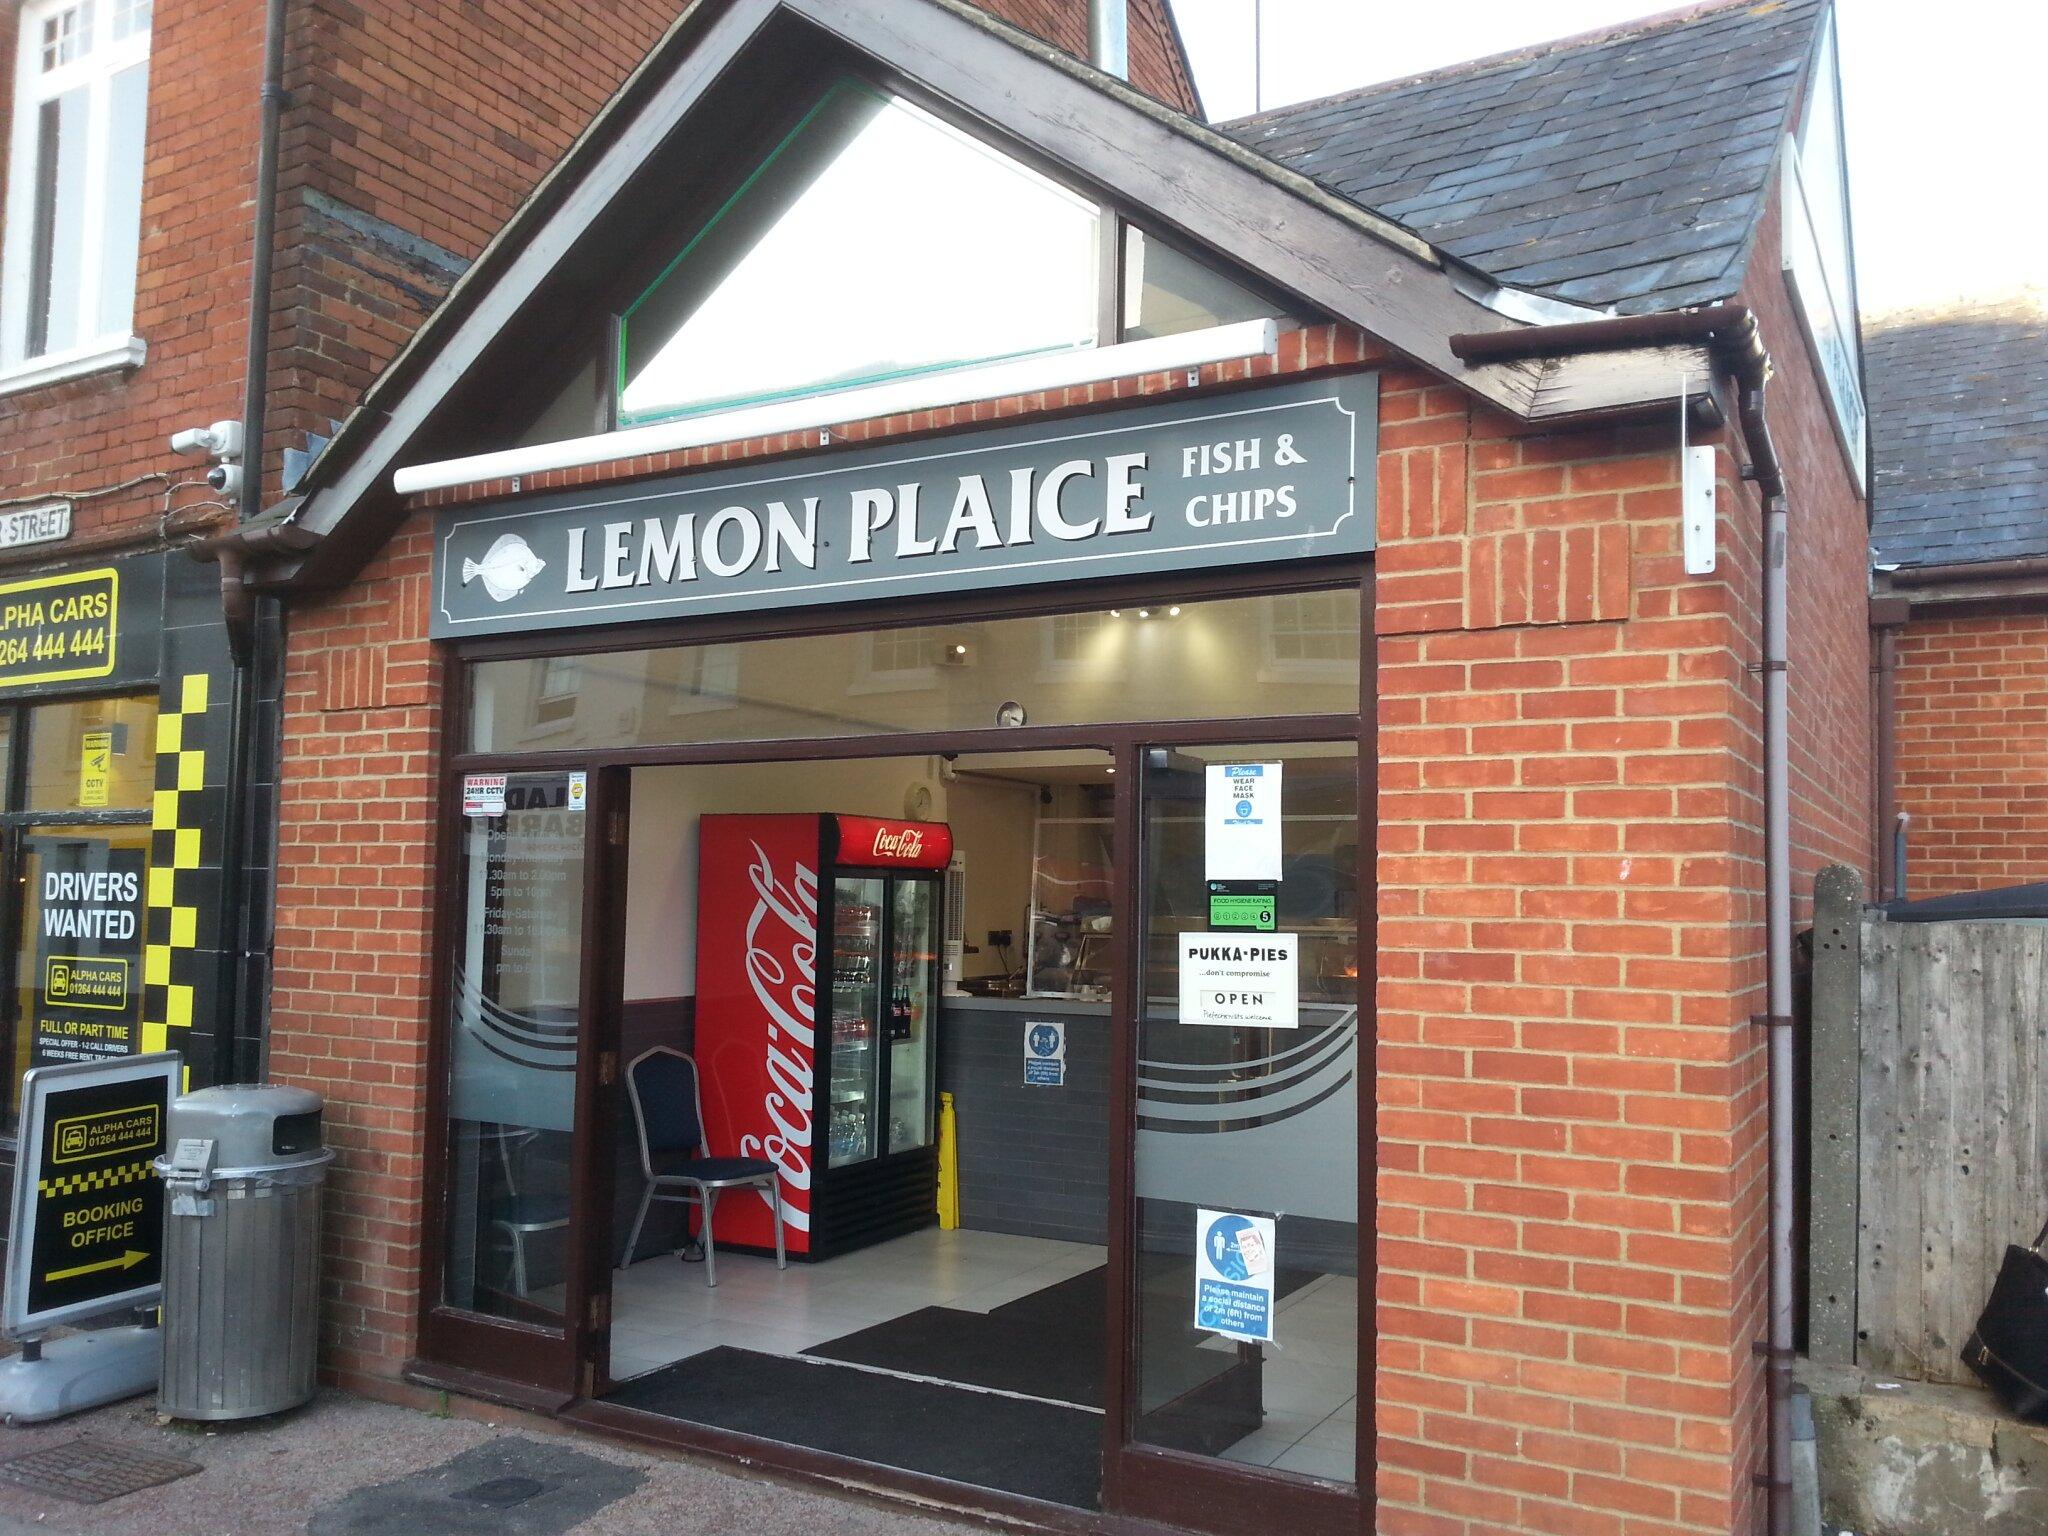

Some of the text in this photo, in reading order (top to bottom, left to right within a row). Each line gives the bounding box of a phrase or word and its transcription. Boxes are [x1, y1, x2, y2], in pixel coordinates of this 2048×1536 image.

[1182, 432, 1307, 479] FISH &
[1184, 484, 1297, 528] CHIPS
[9, 508, 67, 541] STREET
[565, 452, 1154, 593] LEMON PLAICE
[50, 592, 107, 623] CARS
[33, 631, 65, 661] 444
[70, 627, 104, 656] 444
[1231, 767, 1257, 777] Please
[85, 779, 103, 788] CCTV
[466, 786, 504, 795] 24HR CCTV
[467, 778, 504, 786] WARNING
[45, 872, 138, 902] DRIVERS
[44, 908, 135, 939] WANTED
[1262, 912, 1269, 922] 5
[71, 970, 121, 983] ALPHA CARS
[1226, 970, 1270, 978] compromise
[70, 983, 121, 997] 01264 444 444
[1215, 993, 1263, 1005] OPEN
[40, 1020, 128, 1039] FULL OR PART TIME
[39, 1037, 60, 1047] SPECIAL
[61, 1039, 78, 1048] OFFER
[90, 1042, 103, 1051] CALL
[104, 1044, 128, 1053] DRIVERS
[46, 1049, 64, 1059] WEEKS
[65, 1051, 79, 1060] FREE
[91, 1116, 152, 1135] ALPHA CARS
[89, 1127, 151, 1147] 01264 444 444
[63, 1197, 143, 1228] BOOKING
[71, 1221, 134, 1248] OFFICE
[1204, 1284, 1264, 1302] Please maintain
[1204, 1304, 1212, 1312] of
[1214, 1306, 1225, 1315] 2m
[1244, 1311, 1262, 1322] from
[1208, 1295, 1231, 1306] social
[1233, 1300, 1266, 1313] distance
[1221, 1317, 1245, 1328] others
